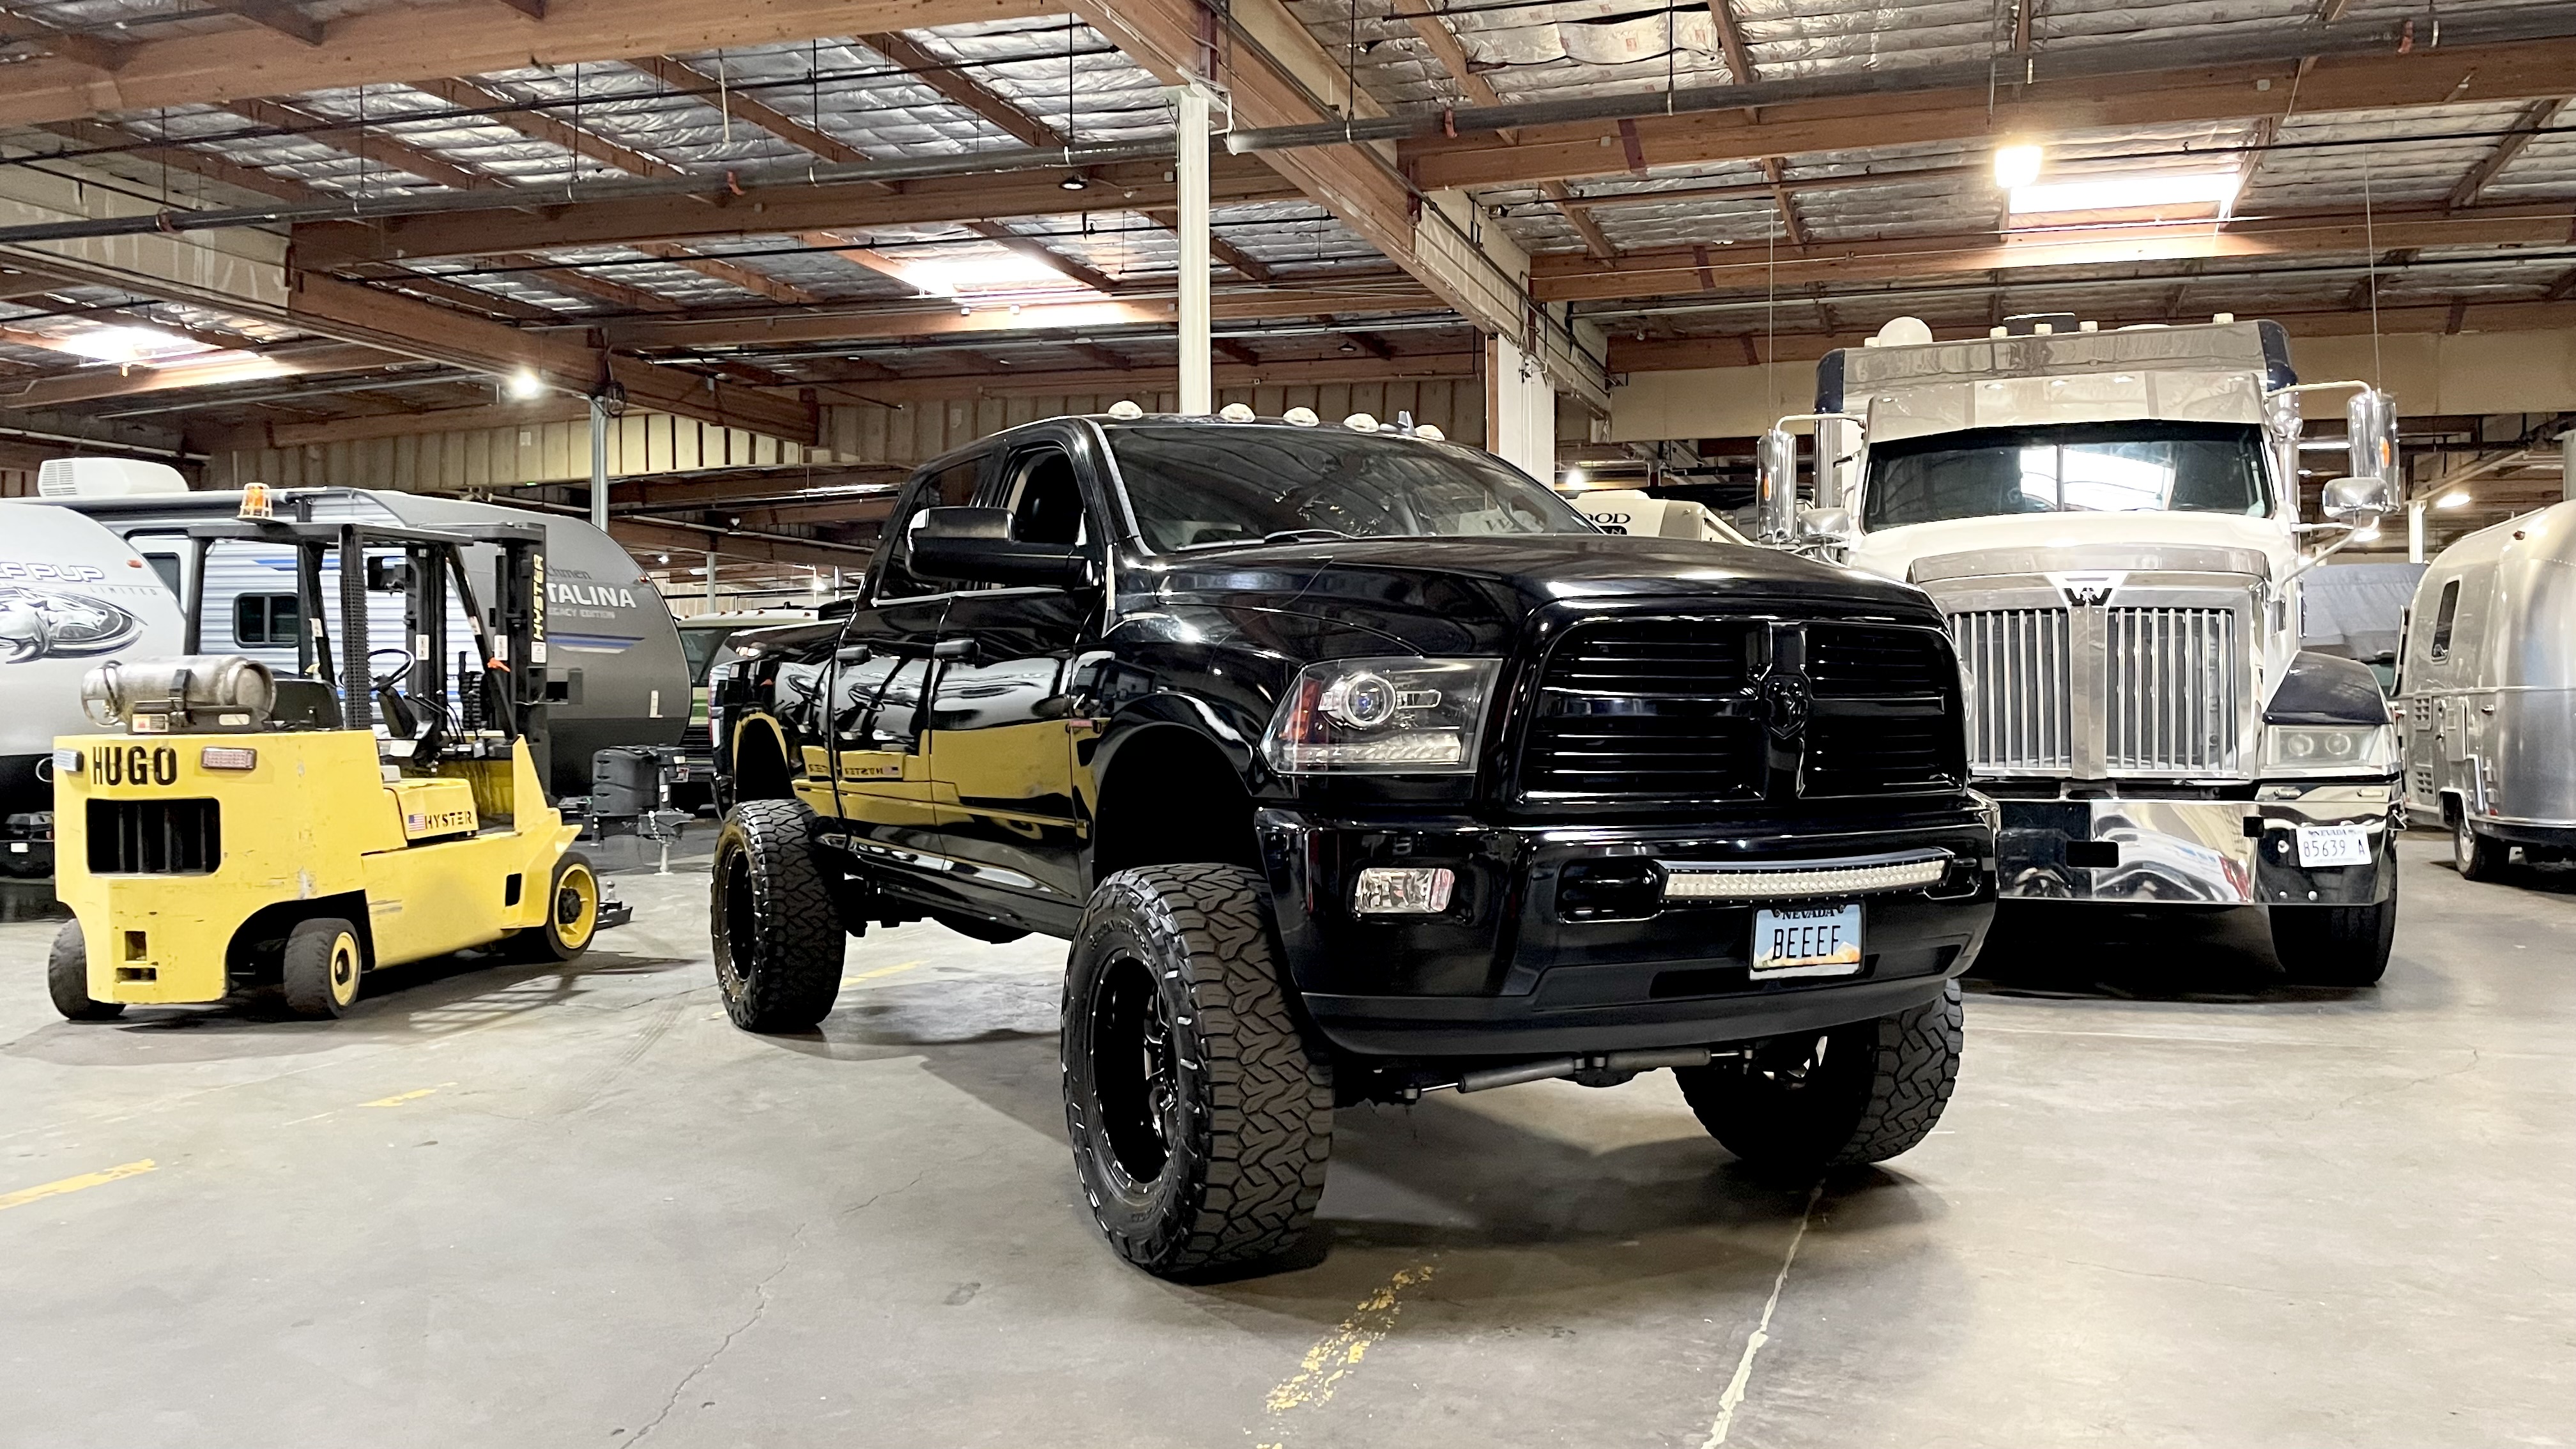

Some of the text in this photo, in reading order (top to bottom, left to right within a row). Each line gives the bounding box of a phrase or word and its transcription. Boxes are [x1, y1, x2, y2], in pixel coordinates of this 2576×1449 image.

[0, 562, 105, 582] F PUP
[89, 586, 158, 596] LIMITED
[533, 554, 544, 641] HYSTER
[546, 583, 636, 608] TALINA
[92, 746, 178, 786] HUGO
[424, 810, 472, 829] HYSTER
[2303, 839, 2366, 857] 85639 A
[1782, 908, 1836, 921] NEVADA
[1772, 925, 1841, 960] BEEEF
